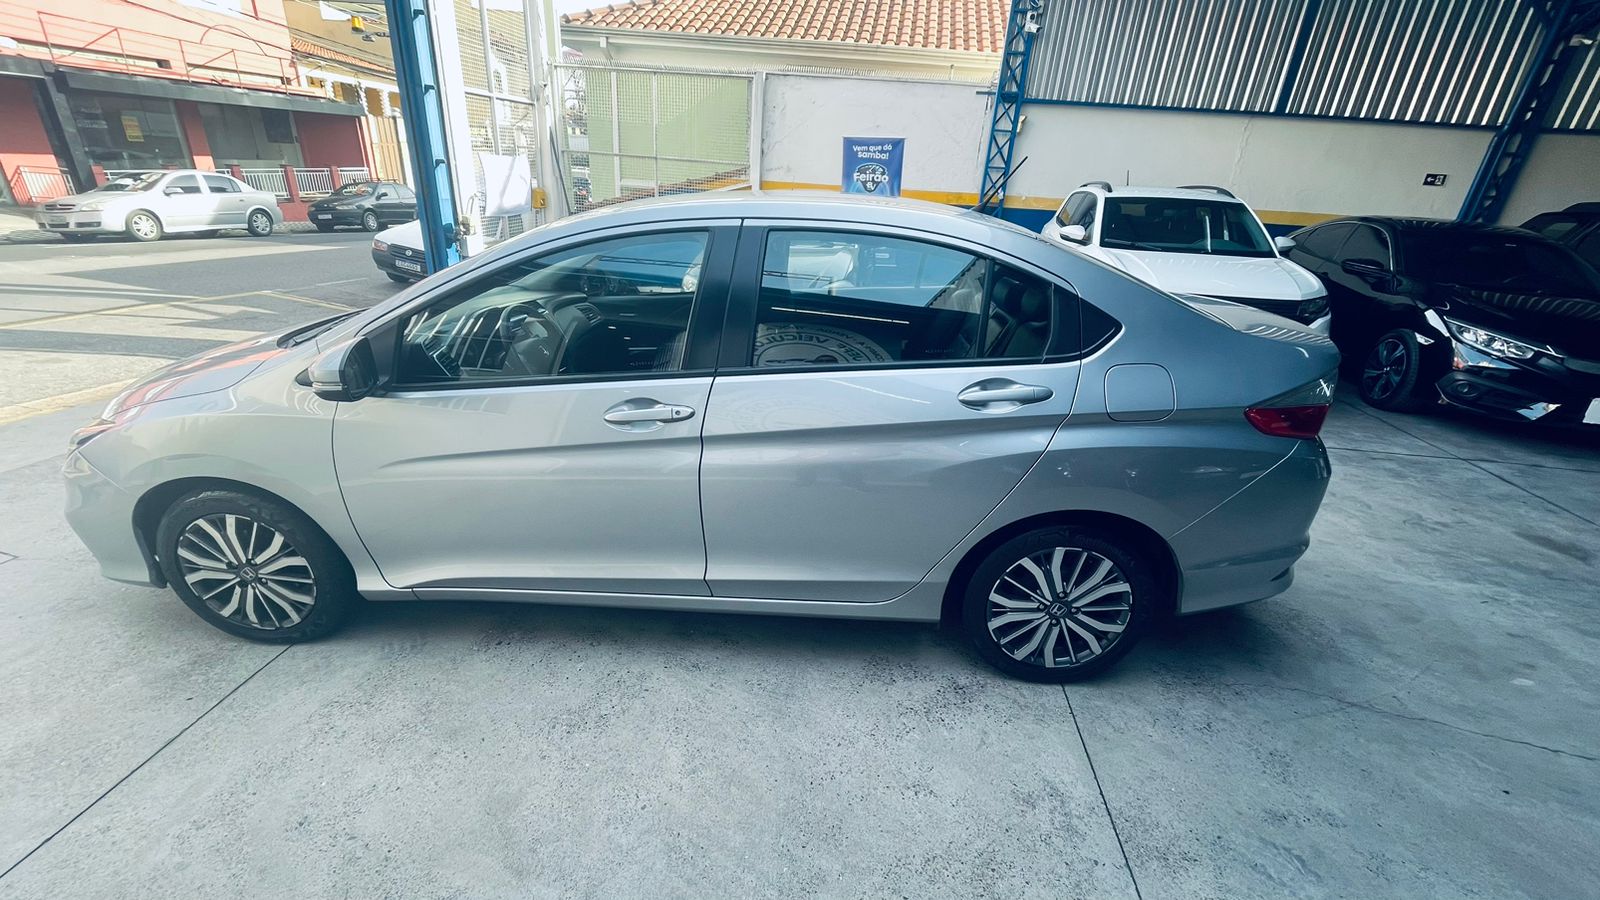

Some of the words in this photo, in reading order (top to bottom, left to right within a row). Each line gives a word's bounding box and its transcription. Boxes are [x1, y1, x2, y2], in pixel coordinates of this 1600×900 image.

[868, 145, 882, 153] que
[857, 151, 889, 160] samba!
[853, 170, 889, 183] Feirão
